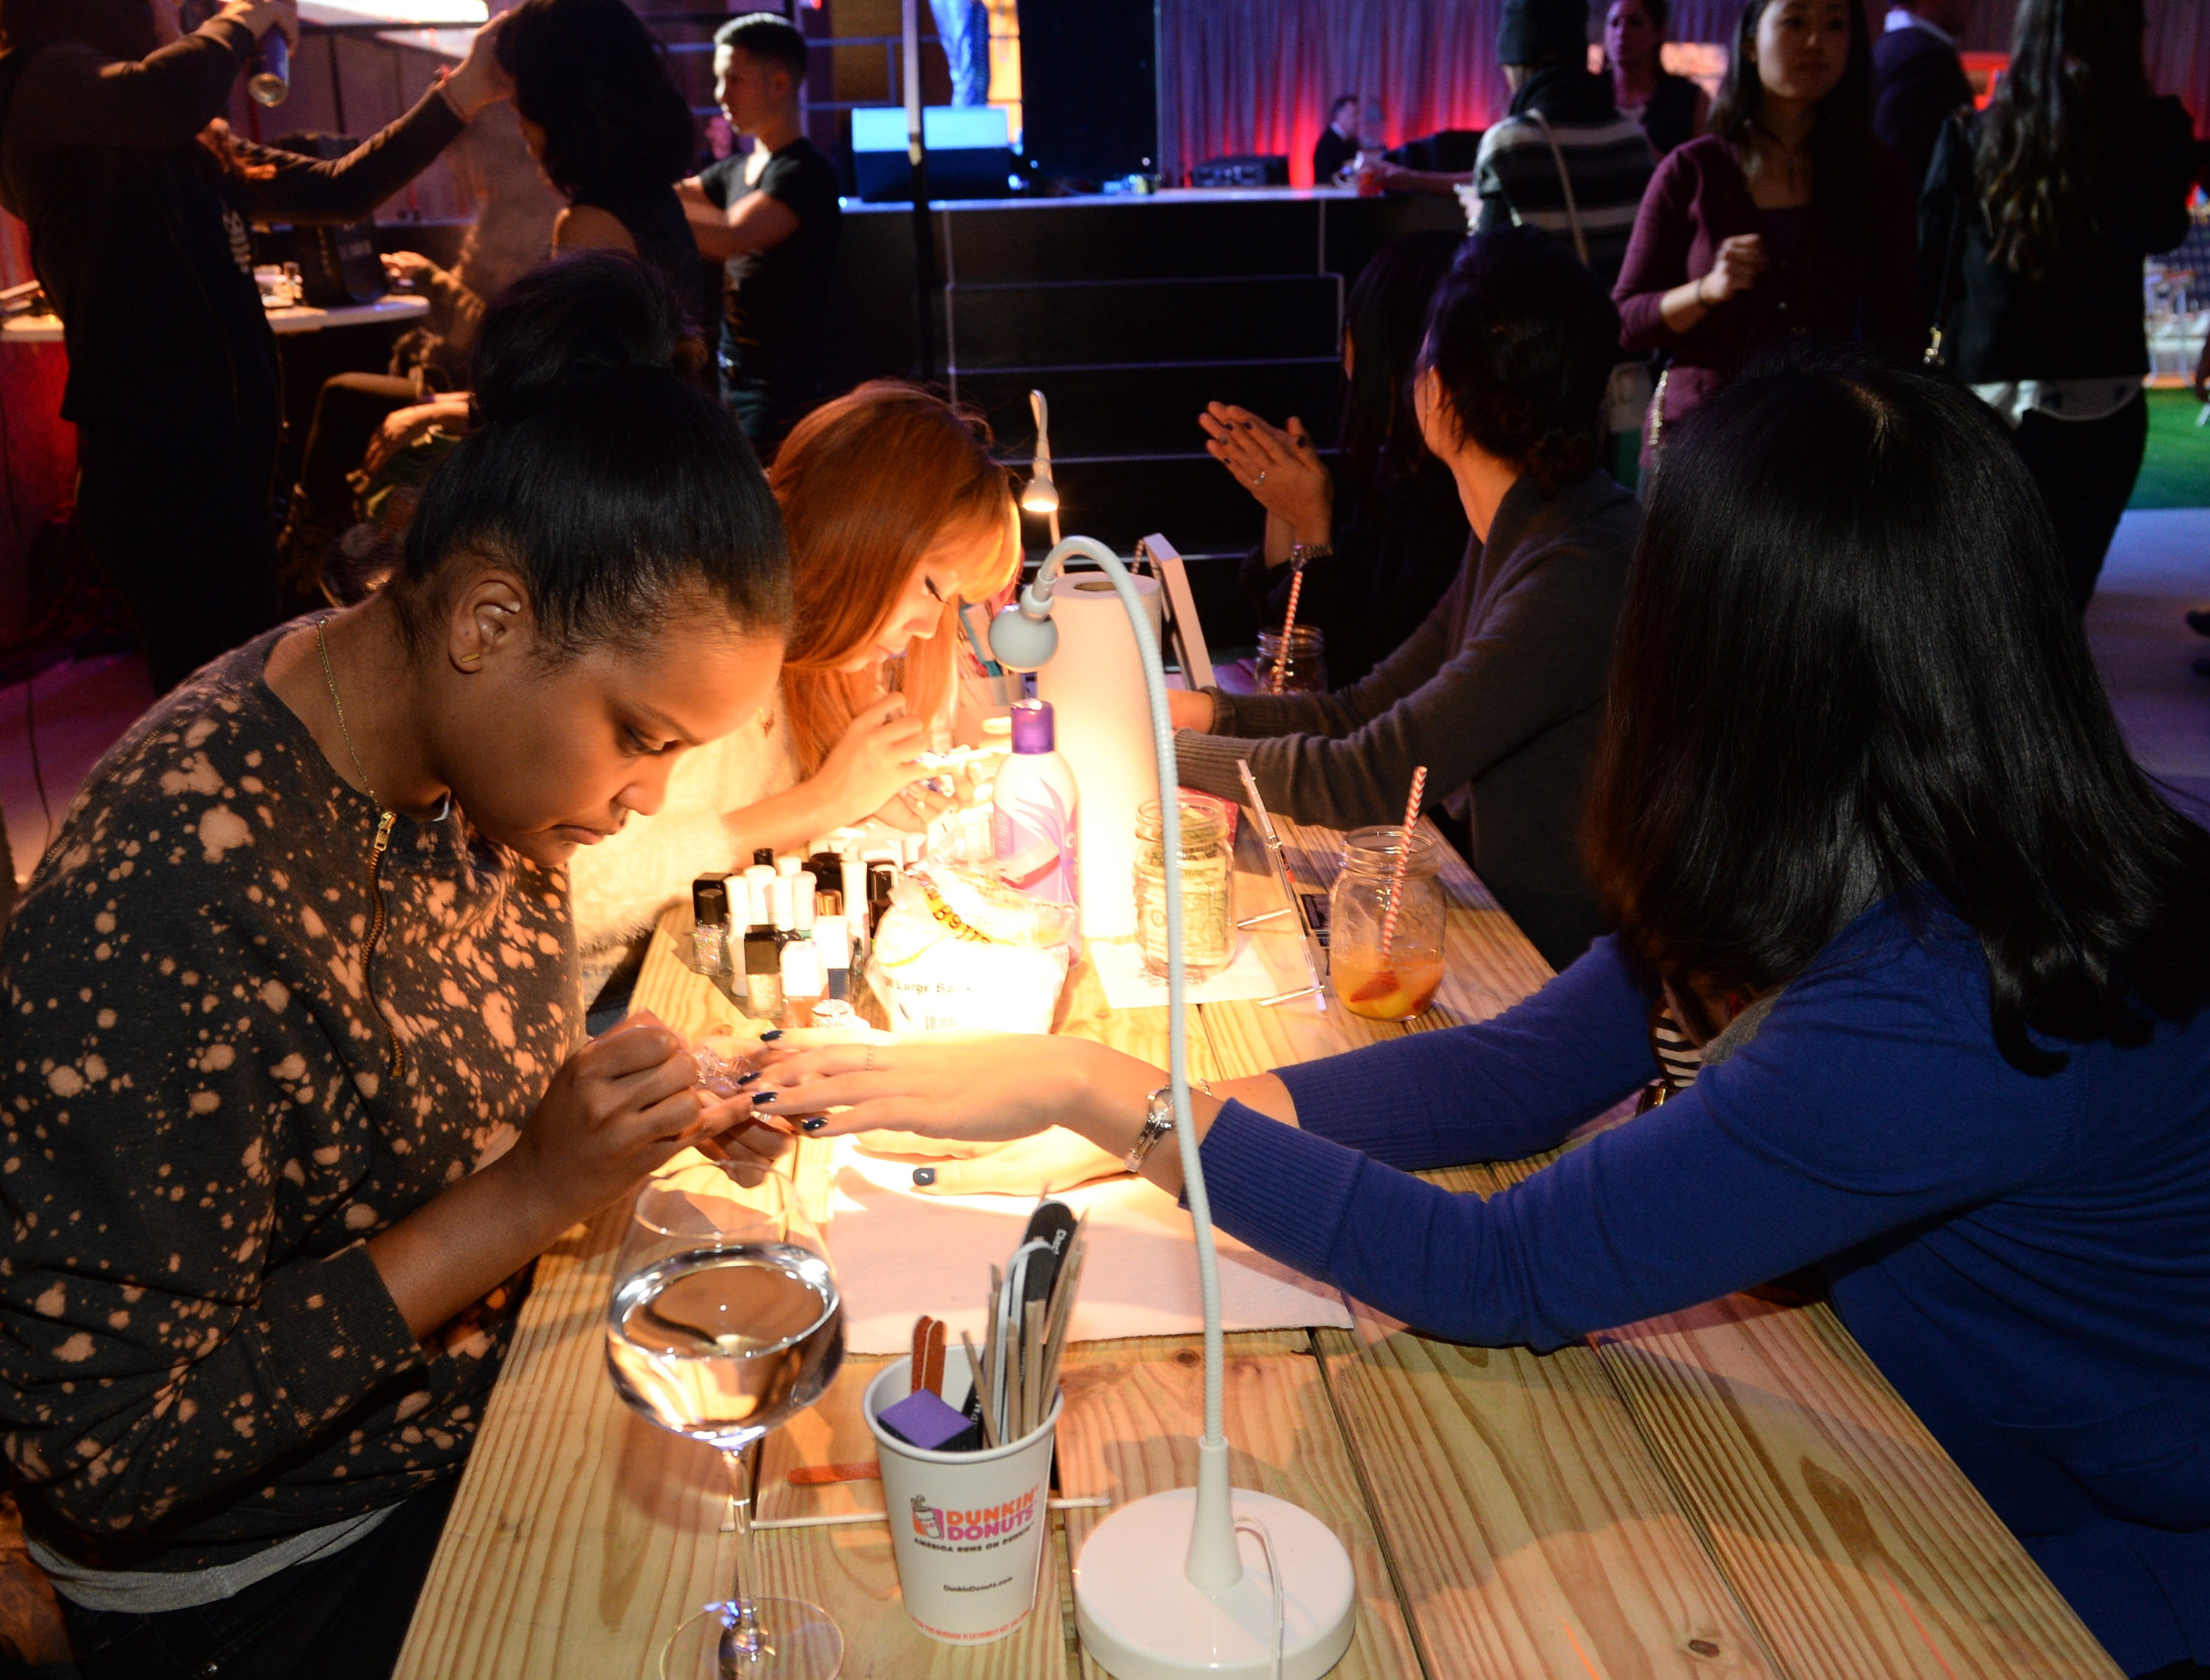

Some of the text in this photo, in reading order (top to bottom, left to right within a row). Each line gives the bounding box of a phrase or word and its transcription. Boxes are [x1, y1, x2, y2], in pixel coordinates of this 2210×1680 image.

[947, 1484, 1039, 1526] DUNKIN'
[947, 1502, 1034, 1541] DONUTS
[914, 1538, 954, 1552] AMERICA
[986, 1542, 999, 1550] ON
